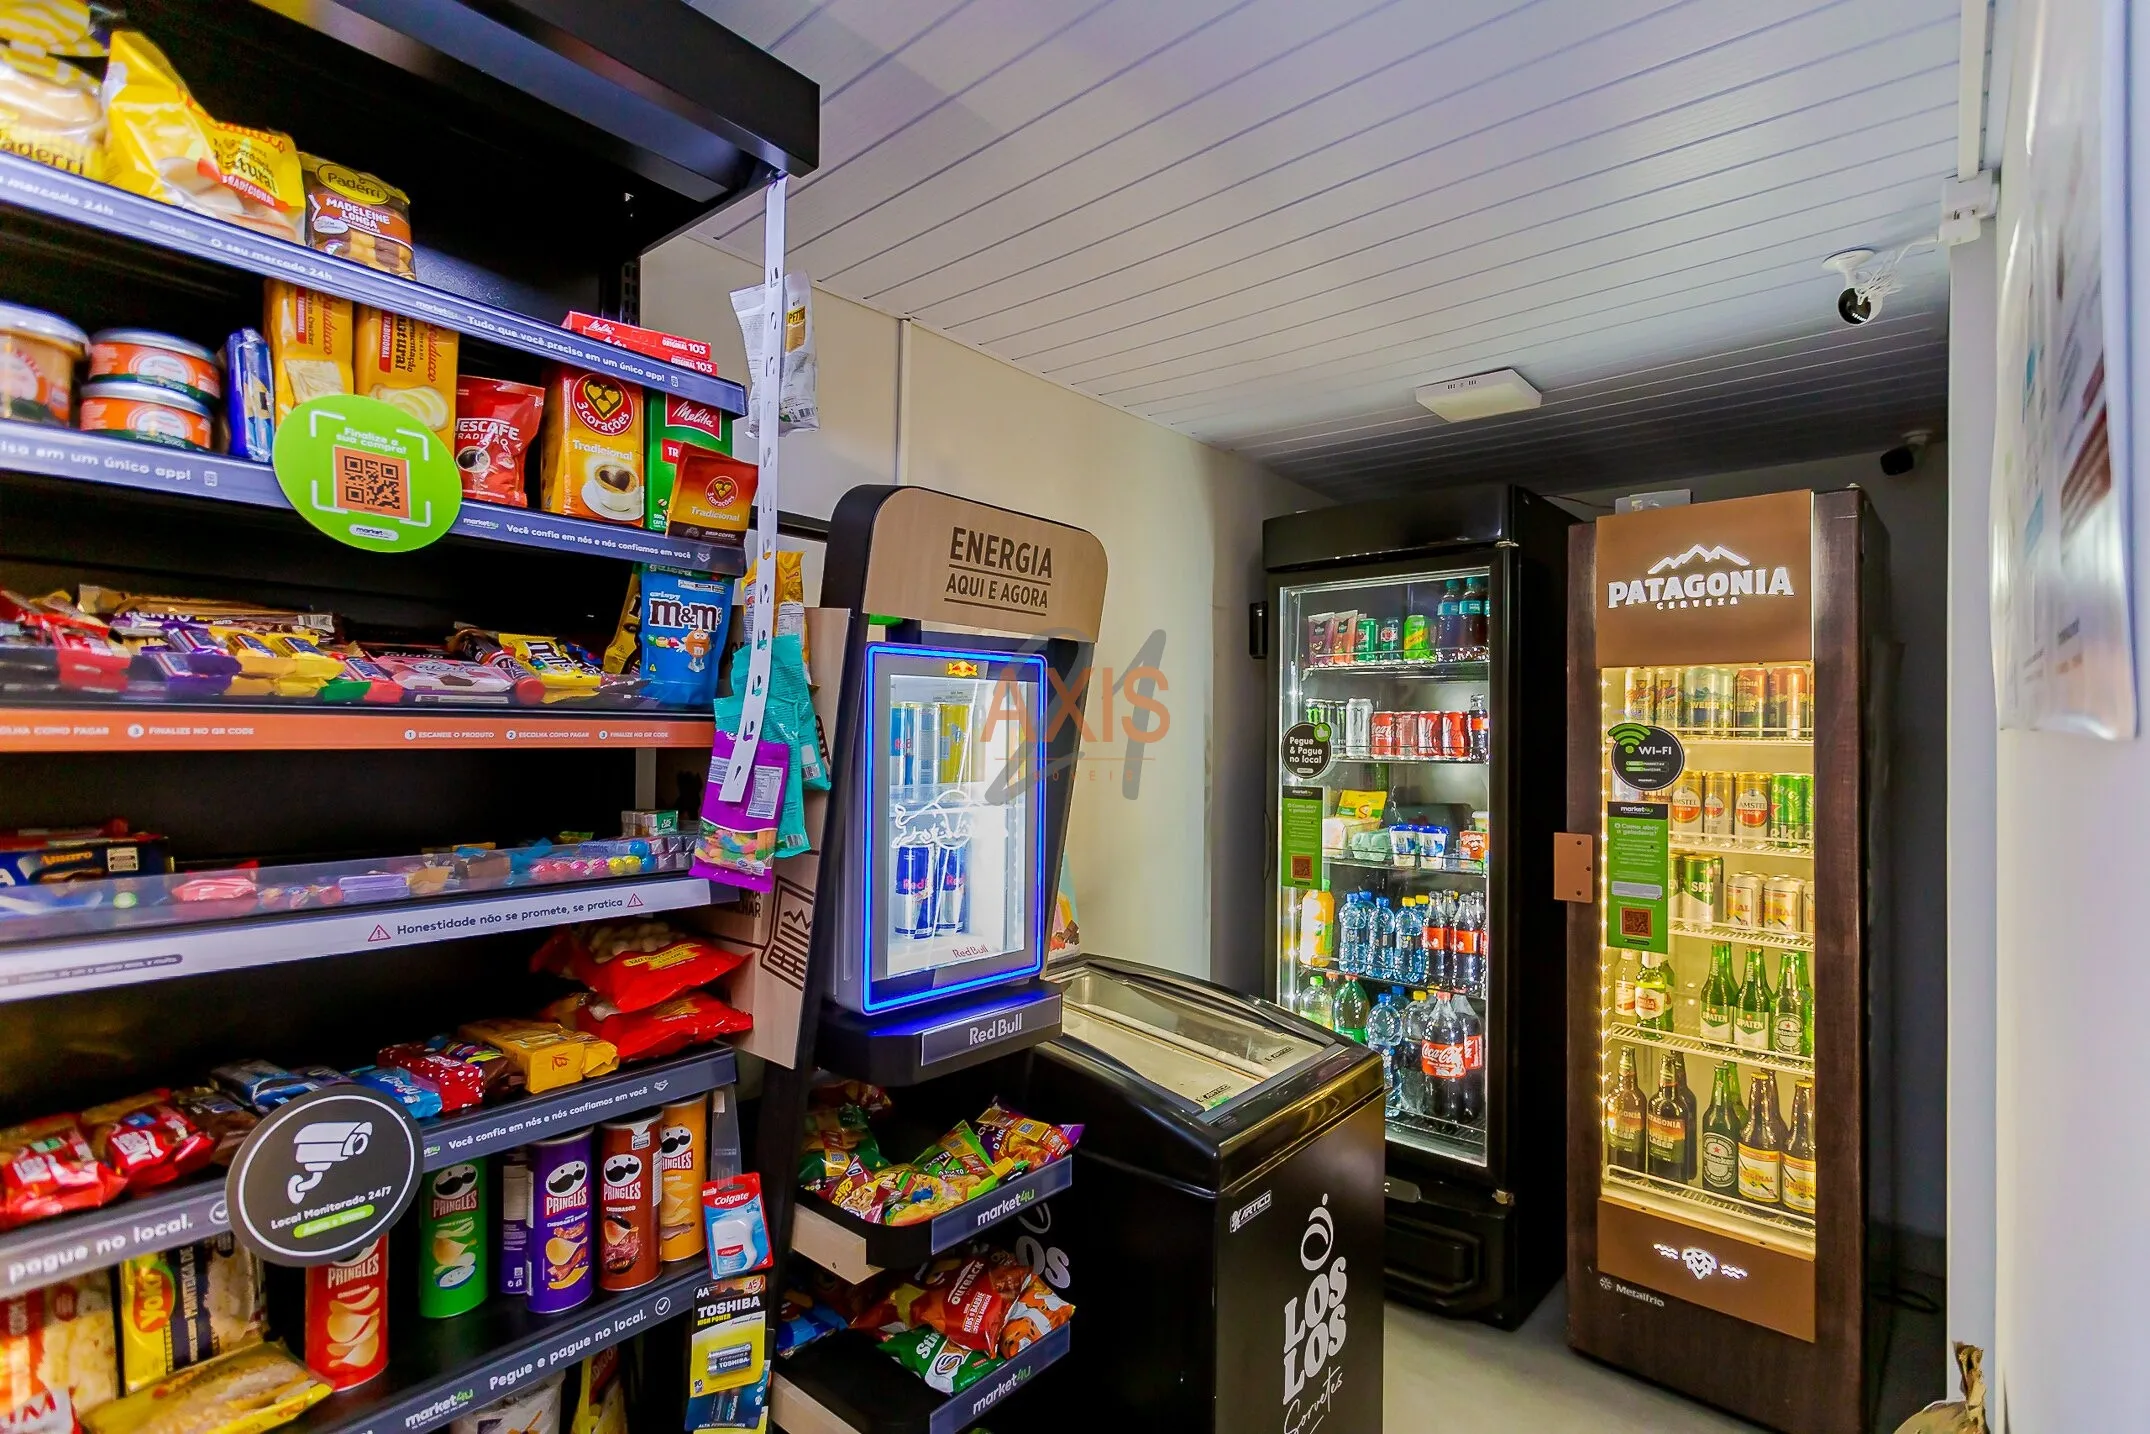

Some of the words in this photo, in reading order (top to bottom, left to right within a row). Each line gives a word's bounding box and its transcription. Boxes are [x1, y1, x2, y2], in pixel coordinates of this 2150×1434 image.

[326, 196, 390, 225] MADELEINE
[341, 210, 378, 229] LONGA
[226, 243, 250, 257] seu
[251, 247, 306, 273] mercado
[309, 267, 333, 281] 24h
[467, 315, 495, 332] Tudo
[497, 325, 518, 338] que
[519, 331, 546, 347] você
[547, 341, 583, 359] preciso
[586, 353, 600, 362] em
[603, 358, 618, 368] um
[620, 361, 644, 376] único
[645, 370, 665, 383] app!
[688, 342, 706, 355] 103
[695, 361, 713, 374] 103
[581, 410, 630, 434] corações
[672, 400, 714, 428] Melitta
[572, 439, 633, 461] Tradicional
[36, 448, 65, 461] em
[71, 454, 99, 466] um
[104, 457, 150, 475] único
[155, 468, 192, 481] app!
[690, 506, 740, 522] Tradicional
[506, 523, 529, 535] Você
[531, 528, 560, 540] confia
[562, 534, 576, 542] em
[577, 534, 592, 546] nós
[602, 537, 617, 549] nós
[618, 541, 659, 554] confiamos
[660, 549, 672, 557] em
[673, 548, 691, 559] você
[949, 525, 1053, 579] ENERGIA
[946, 572, 985, 599] AQUI
[988, 580, 997, 600] E
[1000, 582, 1049, 609] AGORA
[1608, 567, 1795, 609] PATAGONIA
[1656, 597, 1738, 611] CERVEZA
[1289, 736, 1314, 747] Pegue
[1289, 746, 1296, 754] &
[1297, 746, 1323, 756] Pague
[1638, 746, 1672, 756] WI-FI
[1301, 755, 1322, 764] local
[1738, 801, 1767, 809] AMSTEL
[397, 916, 477, 936] Honestidade
[480, 913, 502, 925] não
[505, 910, 518, 921] se
[521, 905, 570, 922] promete,
[573, 903, 585, 913] se
[587, 898, 624, 914] pratica
[952, 947, 972, 959] Red
[969, 1020, 996, 1046] Red
[998, 1012, 1023, 1037] Bull
[1736, 1017, 1764, 1030] SPATEN
[448, 1135, 474, 1151] Você
[475, 1125, 507, 1143] confia
[508, 1121, 524, 1133] em
[525, 1115, 543, 1129] nós
[543, 1115, 550, 1123] e
[551, 1108, 568, 1122] nós
[569, 1096, 614, 1116] confiamos
[615, 1091, 628, 1102] em
[629, 1085, 648, 1100] você
[661, 1153, 692, 1170] INGLES
[432, 1189, 477, 1218] PRINGLES
[545, 1186, 587, 1216] PRINGLES
[603, 1180, 642, 1201] PRINGLES
[714, 1191, 750, 1206] Colgate
[271, 1211, 302, 1231] Local
[304, 1193, 366, 1221] Monitorado
[368, 1184, 393, 1201] 24/7
[976, 1188, 1035, 1227] market4u
[8, 1244, 88, 1286] pague
[96, 1234, 127, 1256] no
[133, 1212, 194, 1244] local.
[327, 1252, 380, 1290] PRINGLES
[951, 1260, 985, 1306] OUTBACK
[696, 1288, 710, 1299] AA
[697, 1296, 761, 1318] TOSHIBA
[1283, 1255, 1348, 1354] LOS
[1616, 1283, 1665, 1307] Metalfrio
[711, 1313, 732, 1324] POWER
[489, 1362, 533, 1391] Pegue
[537, 1358, 546, 1369] e
[550, 1336, 591, 1366] pague
[594, 1327, 611, 1342] no
[614, 1309, 647, 1333] local.
[718, 1357, 750, 1369] TOSHIBA
[1282, 1303, 1347, 1406] LOS
[972, 1364, 1032, 1416] market4u
[404, 1388, 474, 1428] market4u
